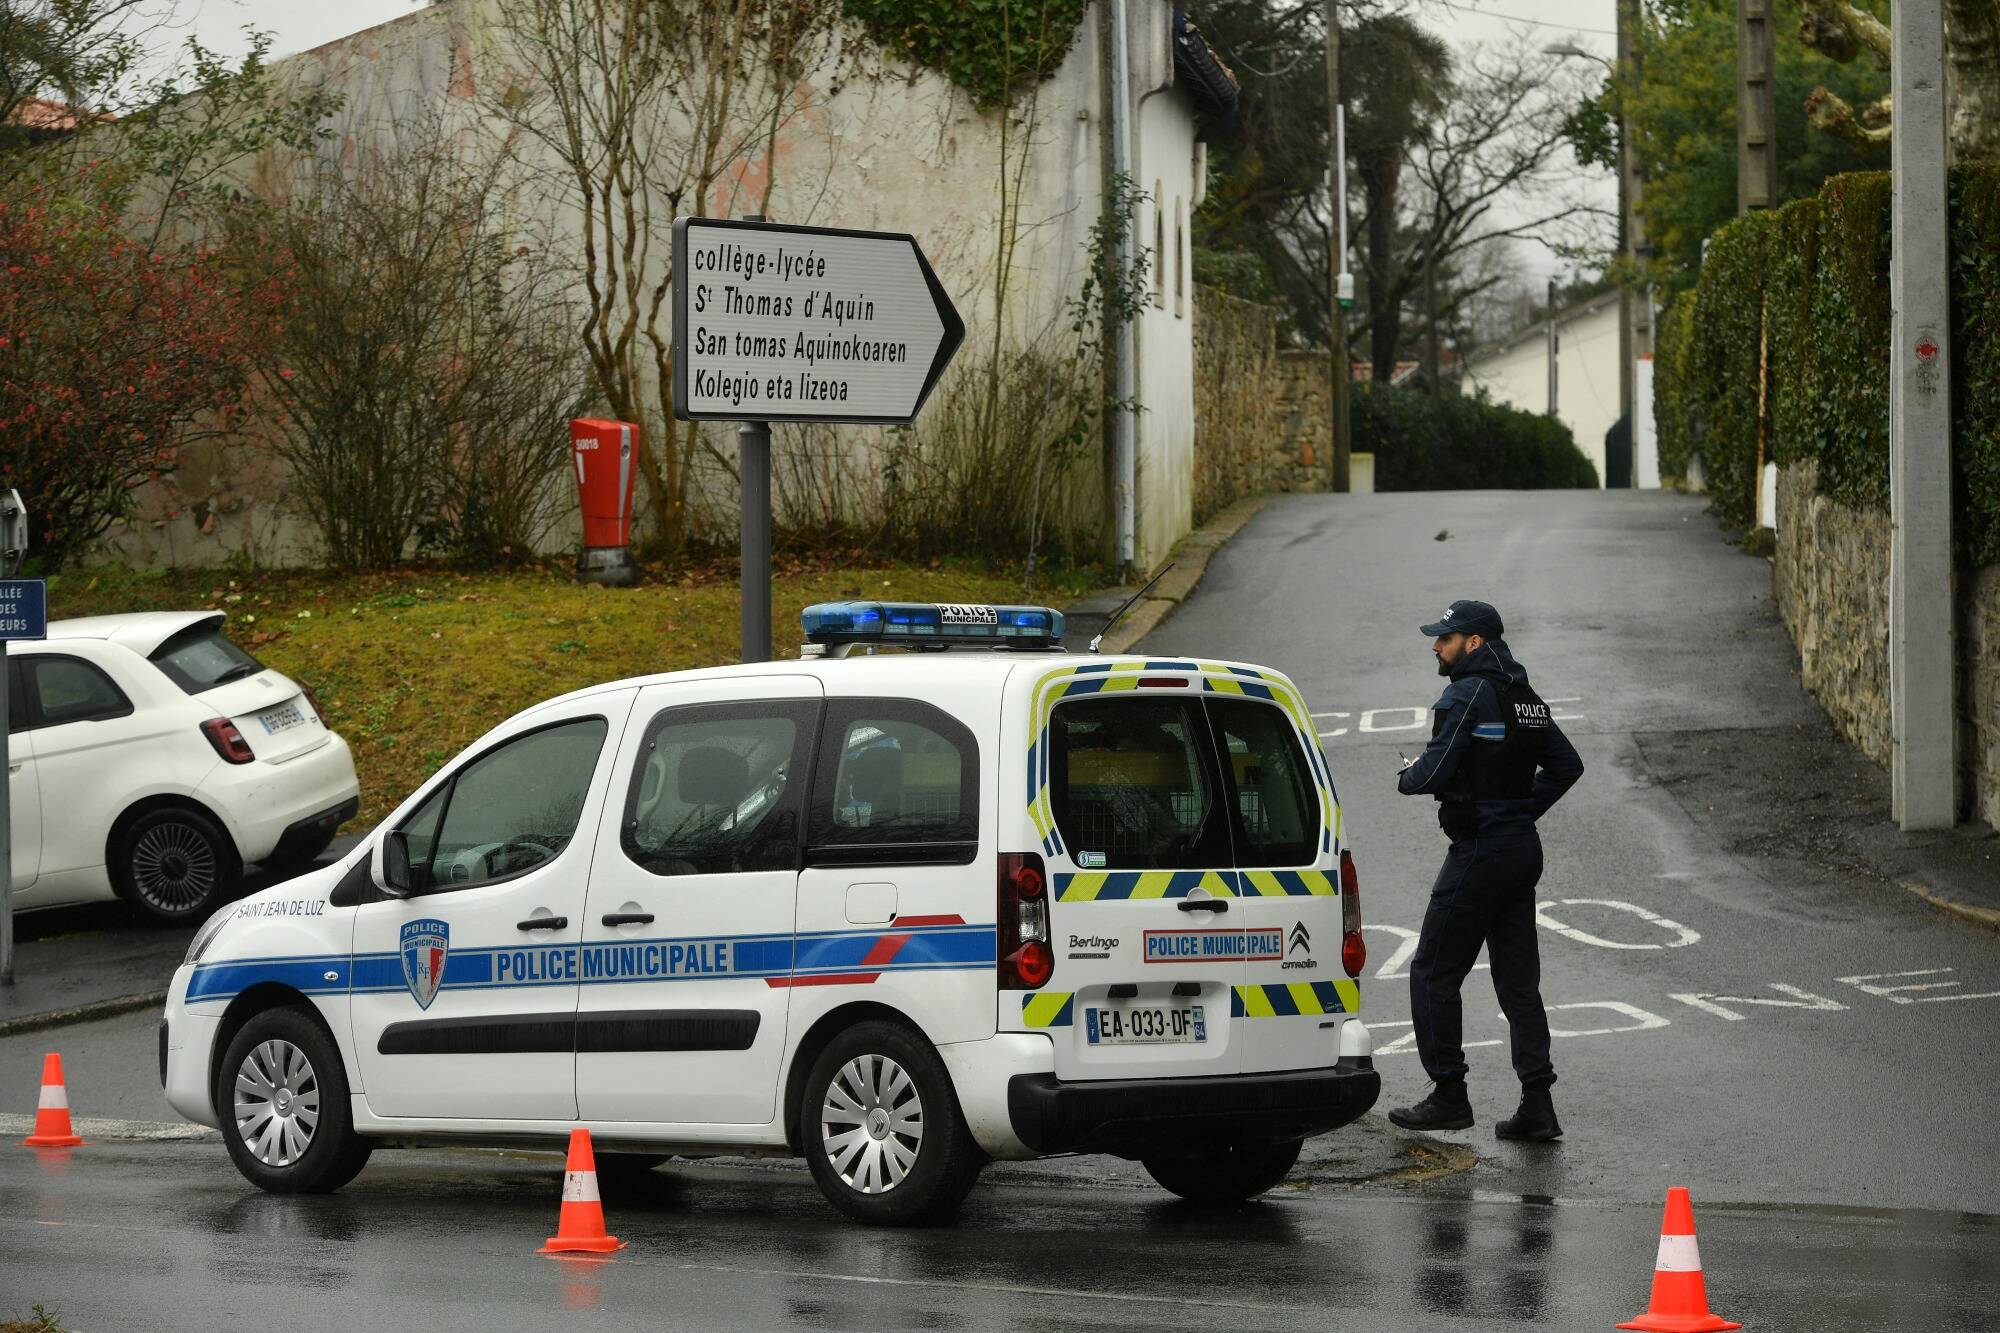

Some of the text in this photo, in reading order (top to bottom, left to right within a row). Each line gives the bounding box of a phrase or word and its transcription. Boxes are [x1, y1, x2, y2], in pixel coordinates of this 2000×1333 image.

[695, 244, 826, 281] collège-lycée
[695, 284, 874, 326] St Thomas d'Aquin
[695, 327, 907, 366] San tomas Aquinokoaren
[695, 369, 848, 406] Kolegio eta lizeoa
[0, 586, 22, 598] LLÉE
[940, 605, 996, 617] POLICE
[1514, 703, 1548, 718] POLICE
[238, 900, 326, 919] SAINT JEAN DE LUZ
[404, 923, 445, 936] POLICE
[404, 939, 445, 950] MUNICIPALE
[1069, 935, 1120, 950] Berlingo
[1148, 934, 1280, 956] POLICE MUNICIPALE
[497, 943, 728, 982] POLICE MUNICIPALE
[1099, 1009, 1192, 1038] EA-033-DF
